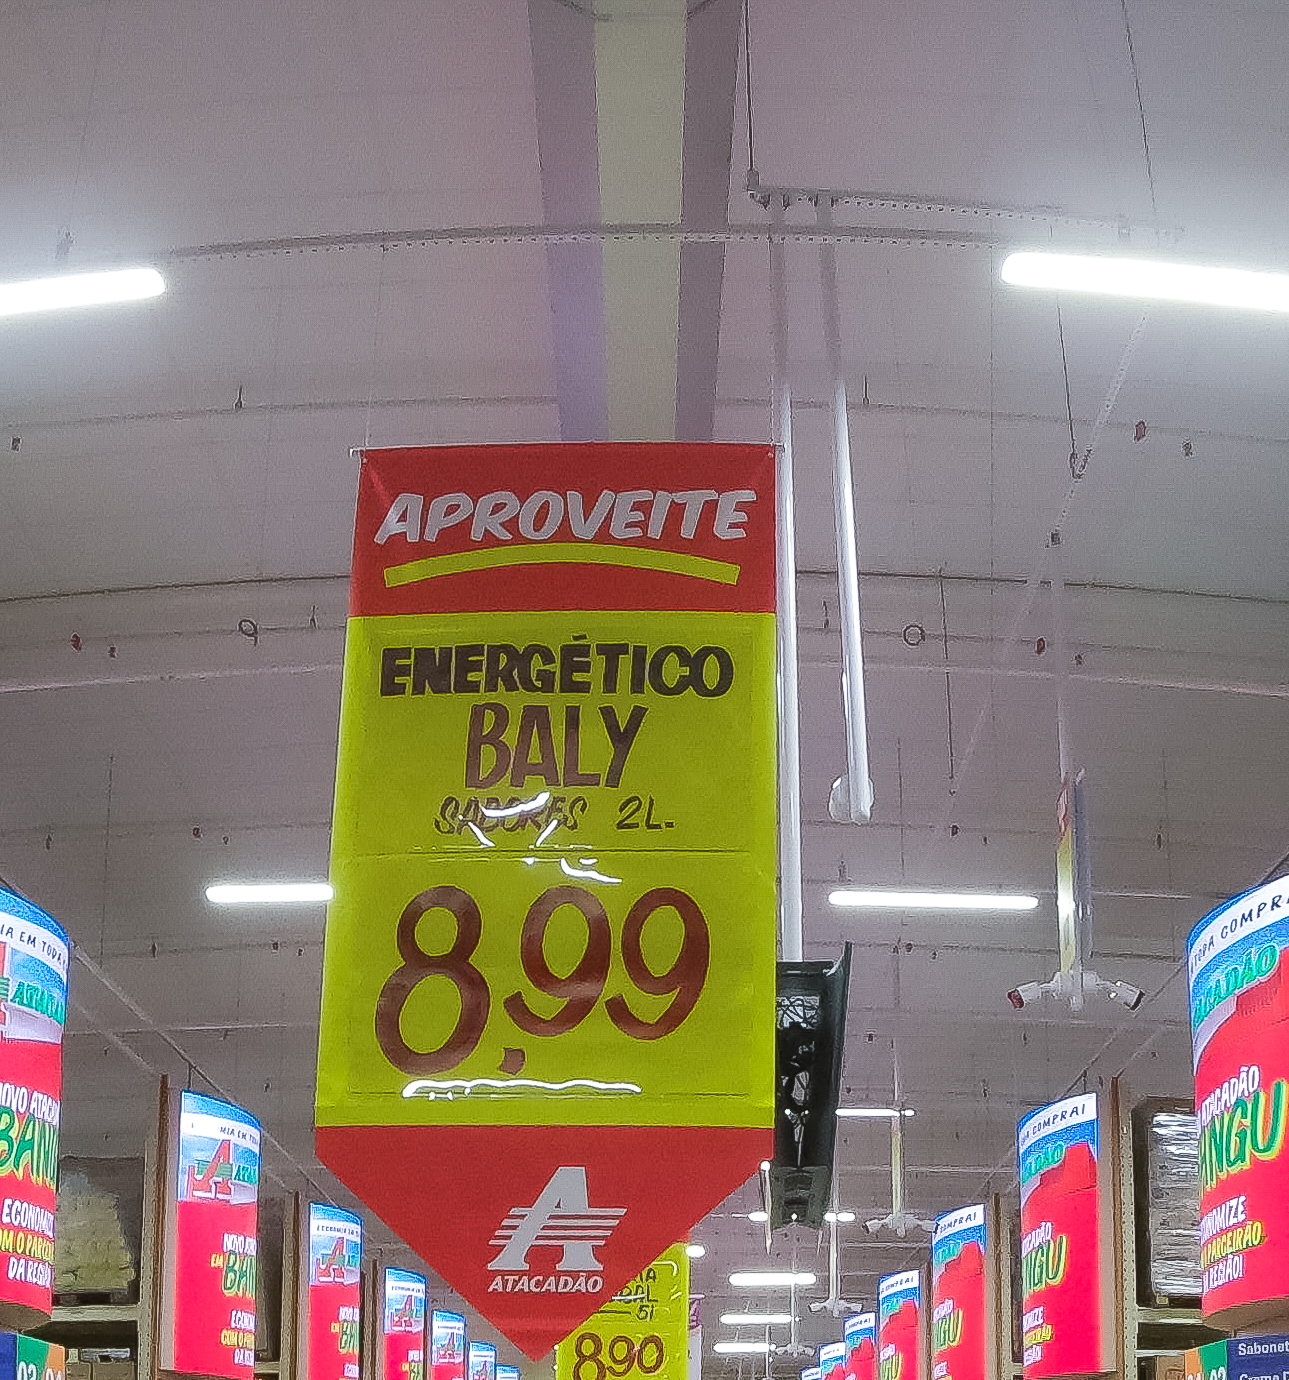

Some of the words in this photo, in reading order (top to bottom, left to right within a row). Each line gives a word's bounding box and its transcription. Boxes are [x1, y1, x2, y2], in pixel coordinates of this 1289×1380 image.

[374, 489, 757, 545] APROVEITE
[379, 634, 735, 698] ENERGÉTICO
[464, 702, 649, 789] BALY
[19, 932, 36, 948] EM
[16, 1231, 25, 1255] O
[487, 1272, 604, 1294] ATACADÃO
